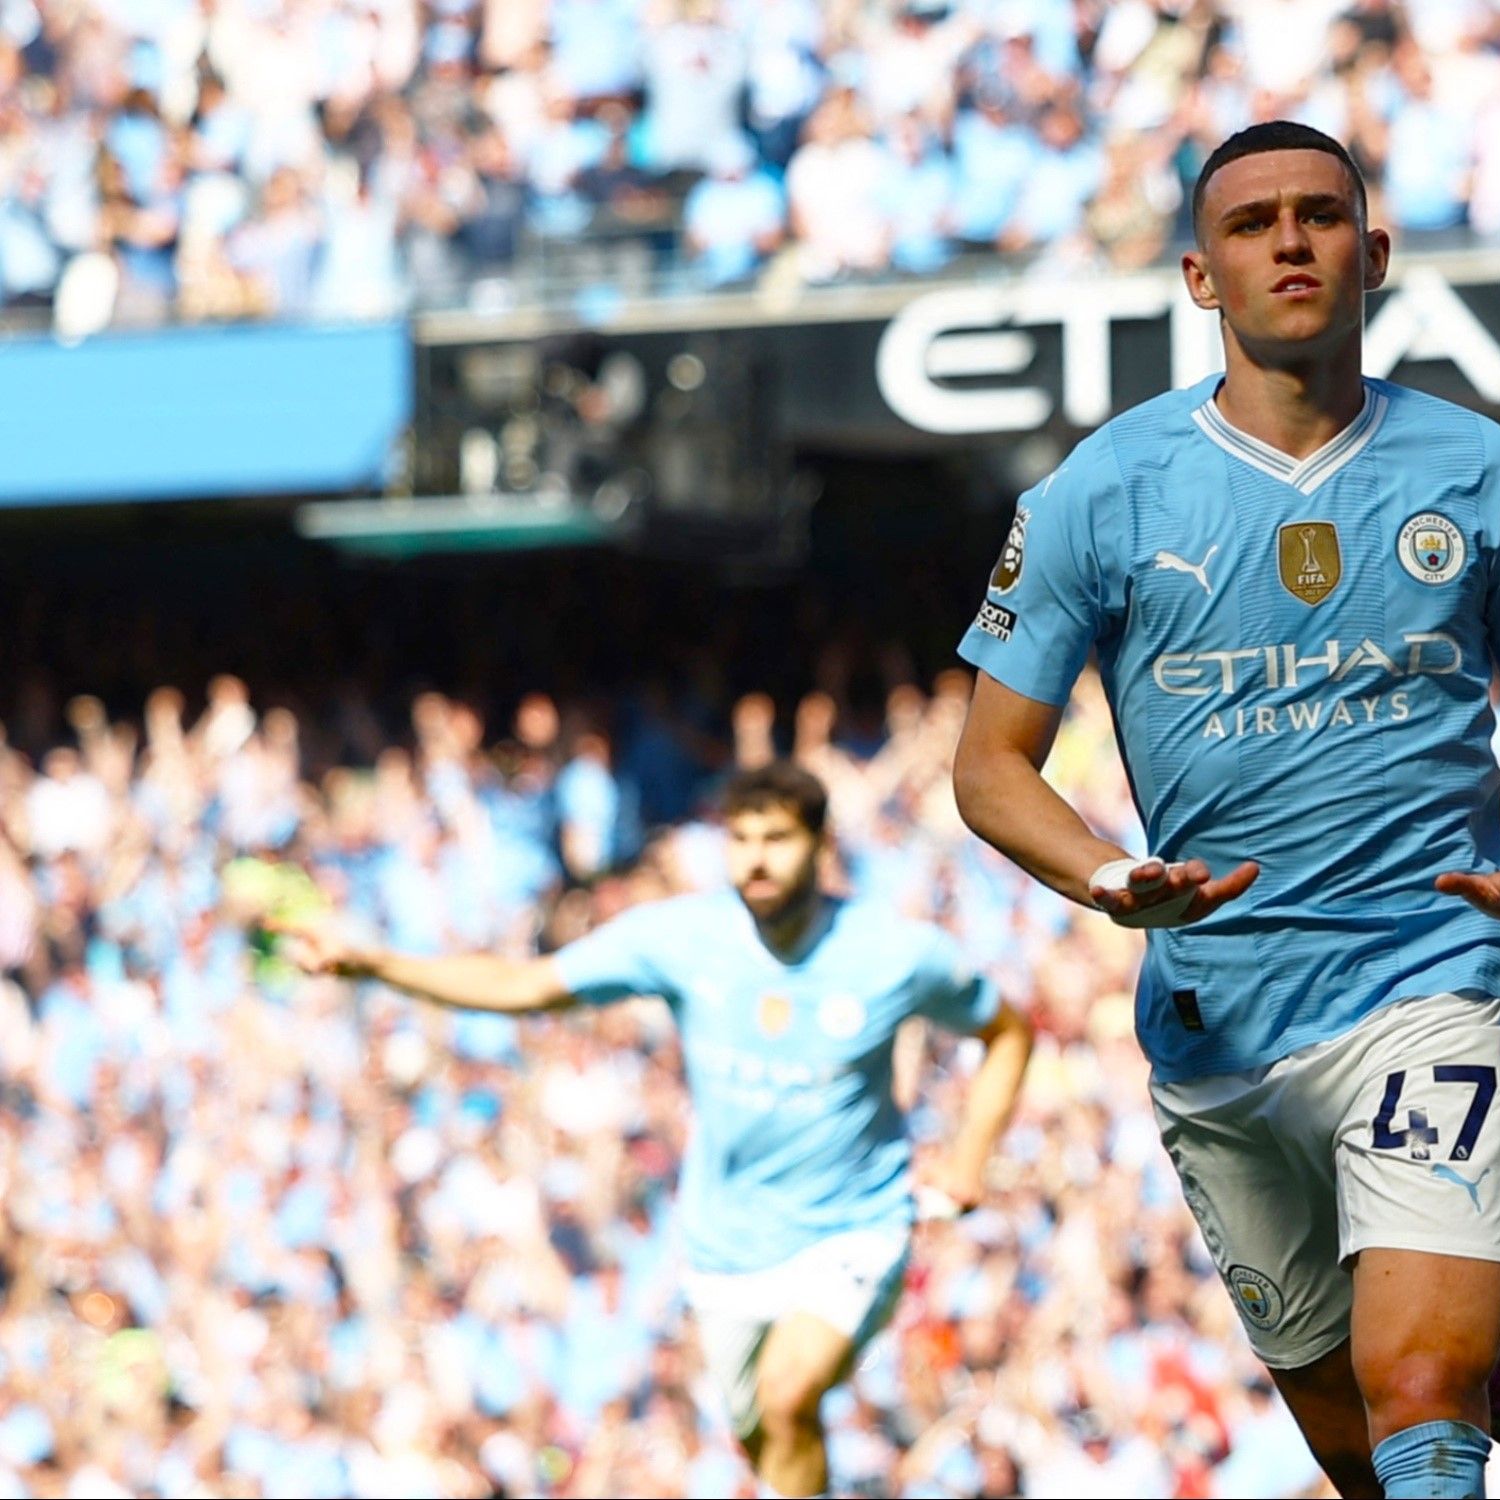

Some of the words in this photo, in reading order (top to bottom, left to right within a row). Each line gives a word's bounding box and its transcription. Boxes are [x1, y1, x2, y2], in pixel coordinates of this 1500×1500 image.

[1402, 517, 1458, 540] MANCHESTER
[1297, 573, 1327, 585] FIFA
[1424, 573, 1445, 581] CITY
[1153, 632, 1462, 696] ETIHAD
[1203, 692, 1410, 738] AIRWAYS
[1371, 1064, 1497, 1161] 47
